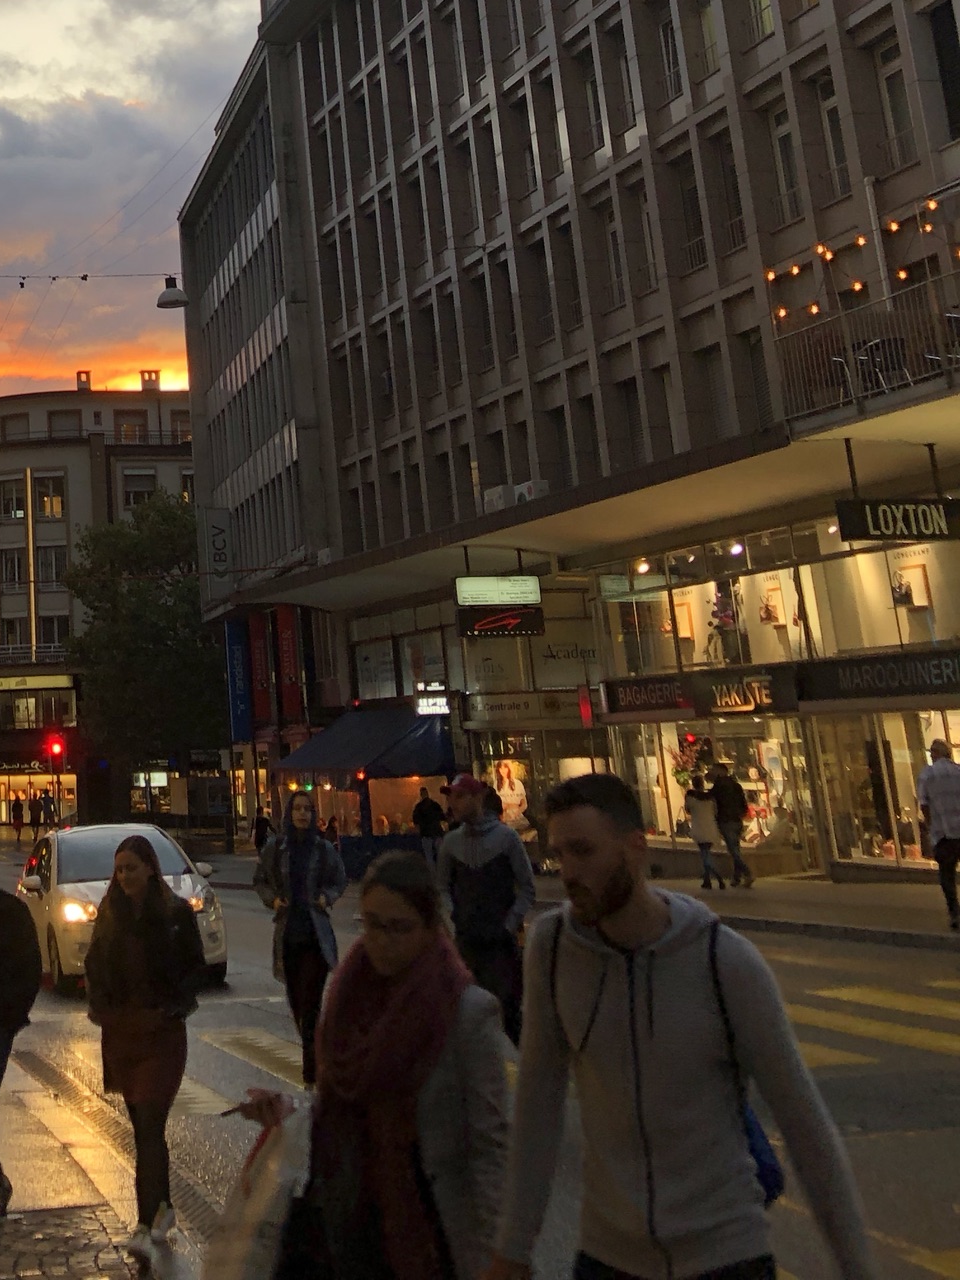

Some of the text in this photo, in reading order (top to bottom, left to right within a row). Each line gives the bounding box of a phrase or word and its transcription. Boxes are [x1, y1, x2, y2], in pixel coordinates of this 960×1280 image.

[865, 504, 949, 536] LOXTON
[212, 525, 227, 563] BCV
[231, 645, 244, 694] randstad
[418, 706, 450, 715] CENTRAL
[484, 701, 521, 711] Centrale
[523, 701, 530, 710] 9
[618, 676, 772, 712] BAGAGERIE YAKISTE
